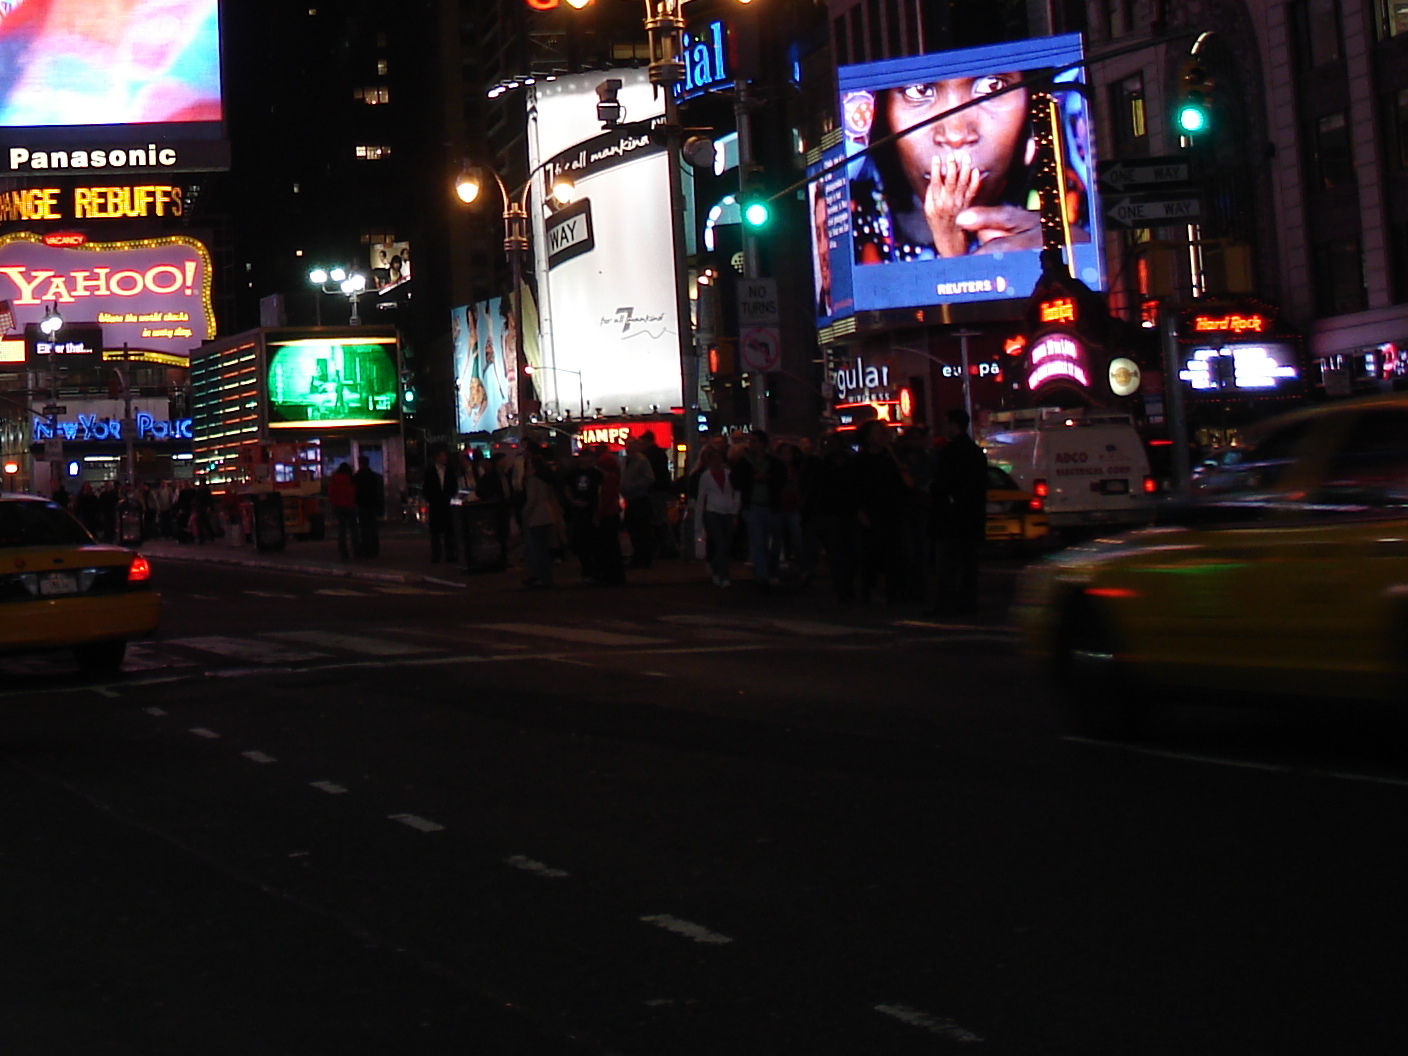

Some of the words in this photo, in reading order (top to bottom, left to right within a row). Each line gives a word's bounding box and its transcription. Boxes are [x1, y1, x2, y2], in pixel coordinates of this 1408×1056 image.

[10, 144, 177, 169] Panasonic
[1110, 168, 1136, 183] ONE
[1154, 164, 1180, 180] WAY
[75, 185, 183, 219] REBUFFS
[1117, 204, 1145, 219] ONE
[1164, 200, 1192, 216] WAY
[45, 236, 84, 245] VACANCY
[549, 220, 577, 251] WAY
[748, 285, 766, 298] NO
[937, 279, 992, 296] REUTERS
[1195, 316, 1229, 331] Hard
[1230, 315, 1262, 333] Rock
[78, 413, 121, 441] YOR
